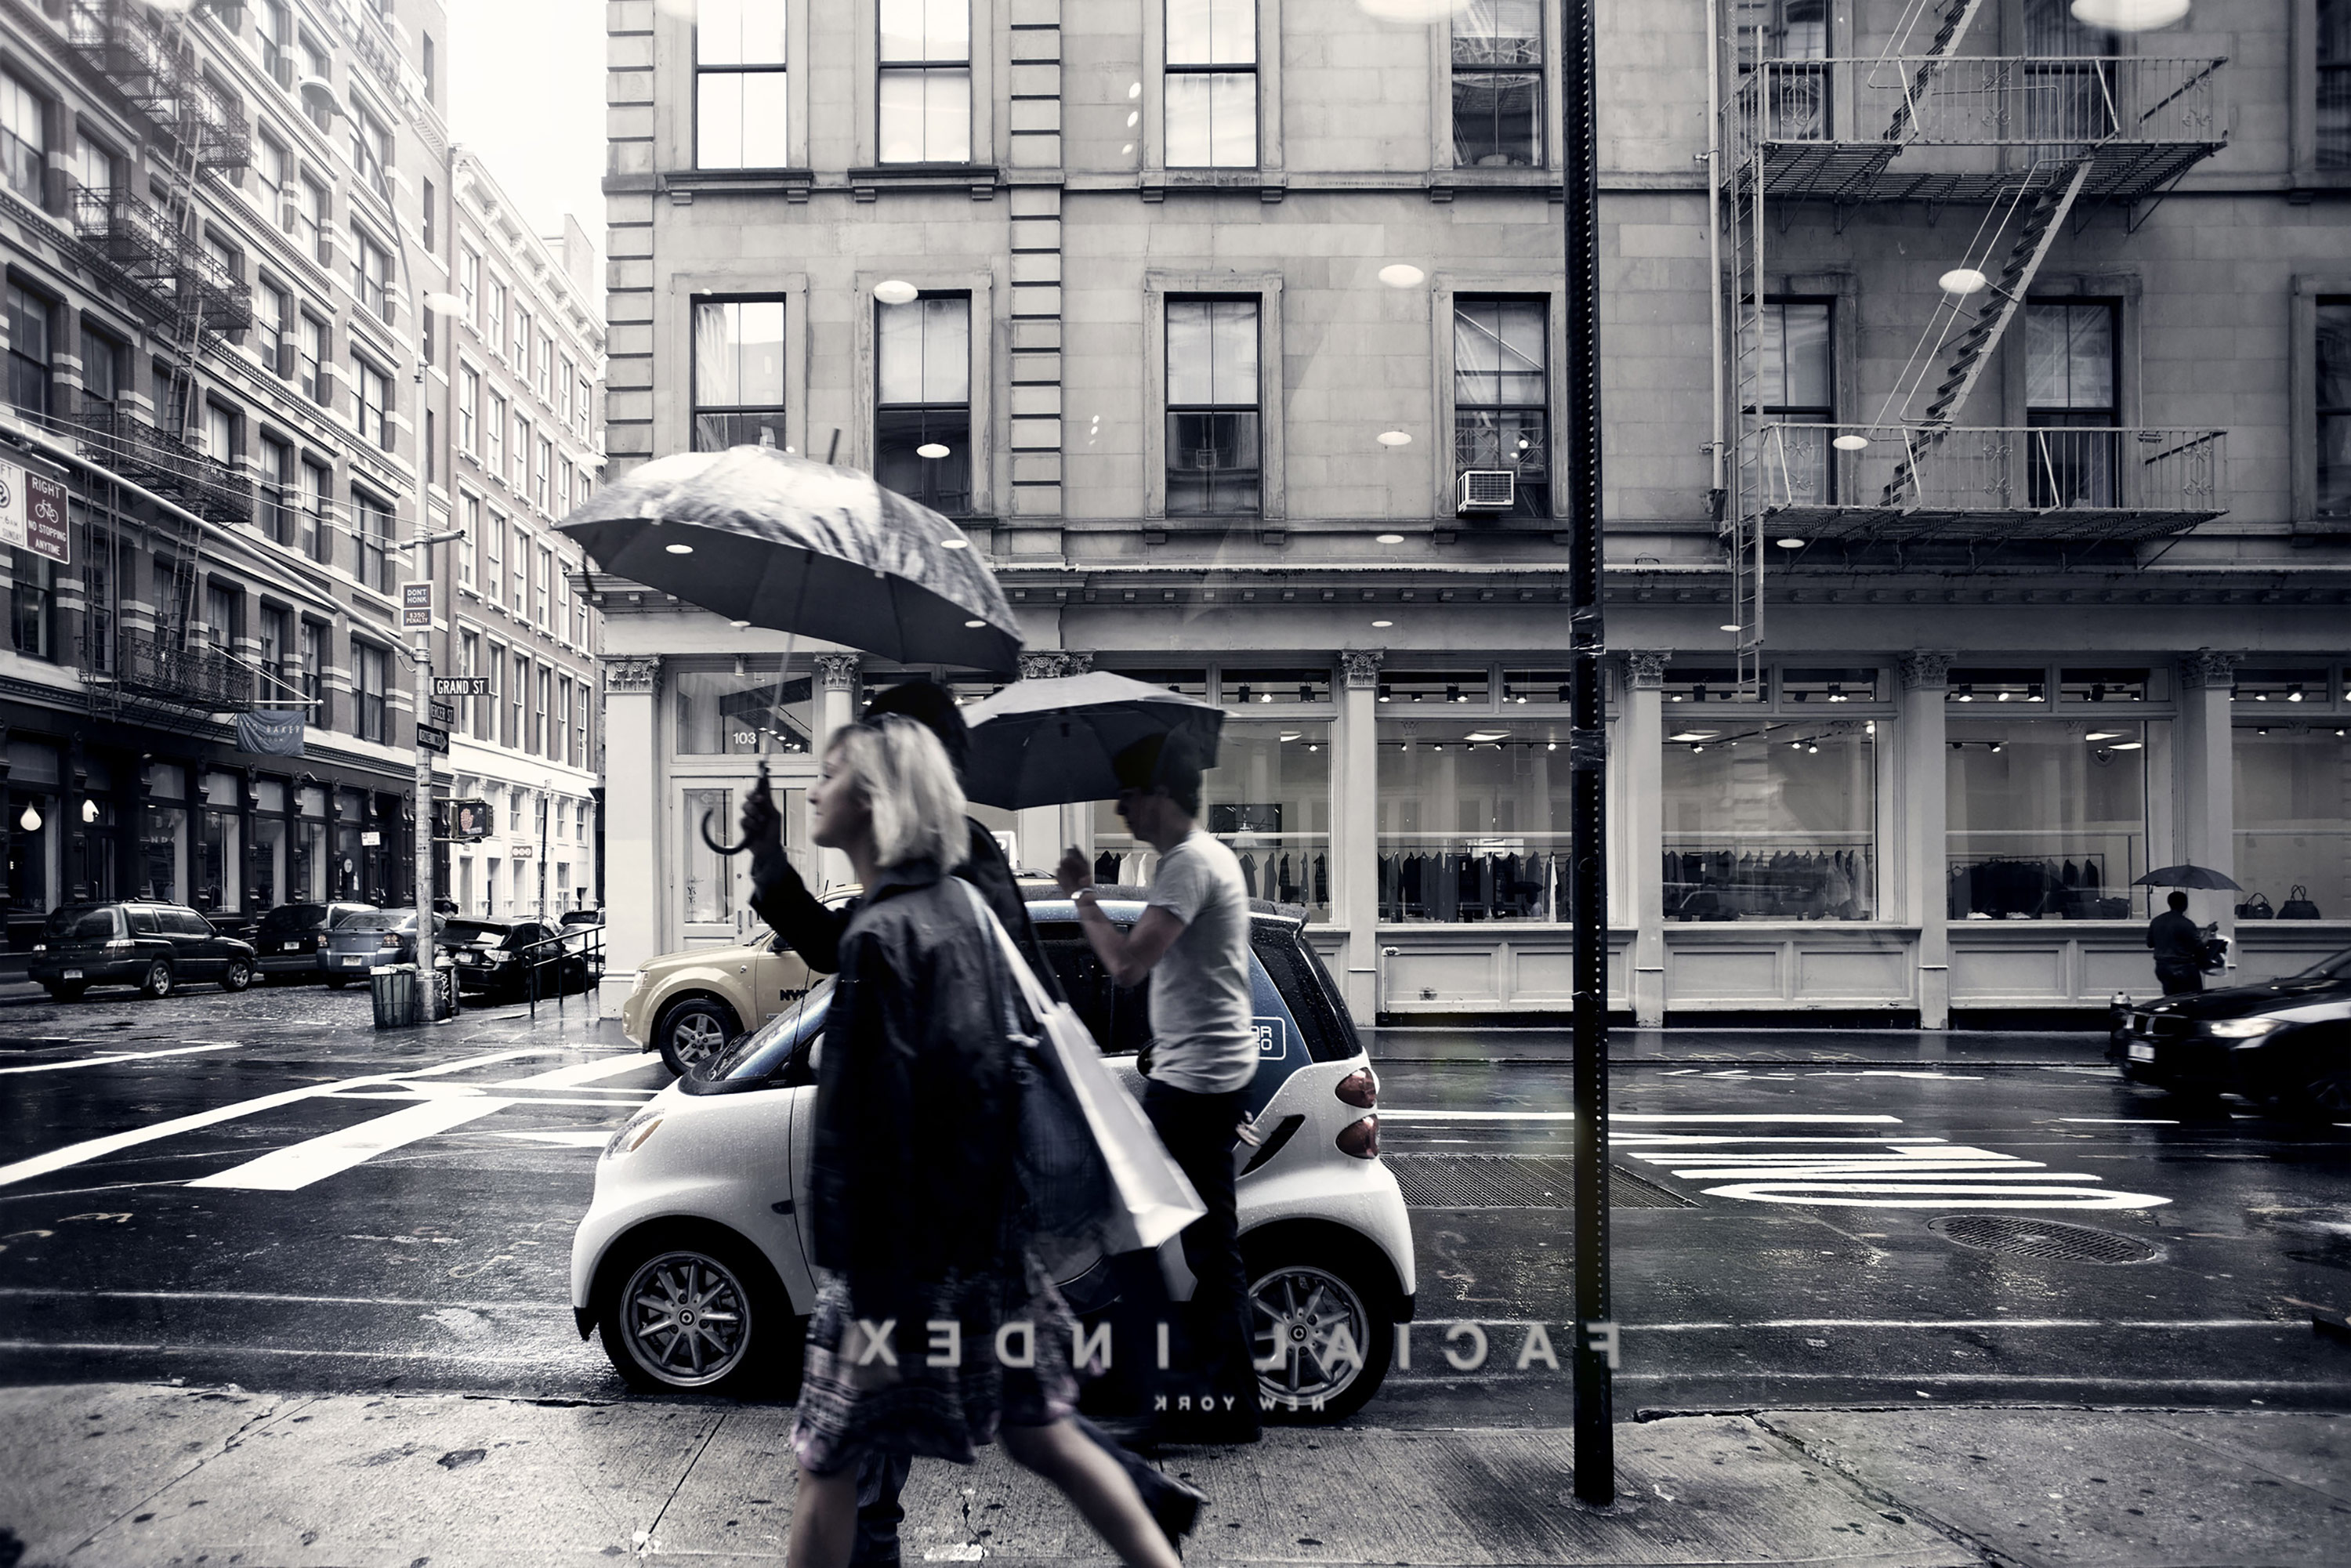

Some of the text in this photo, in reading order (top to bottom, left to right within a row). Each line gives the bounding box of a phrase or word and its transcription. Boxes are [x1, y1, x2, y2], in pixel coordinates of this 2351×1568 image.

[32, 476, 60, 498] RIGHT
[28, 520, 67, 542] NO STOPPING
[35, 538, 60, 556] ANYTIME
[437, 679, 484, 695] GRAND ST
[432, 704, 454, 722] ERCER ST
[266, 725, 301, 734] BAKER
[420, 730, 445, 746] ONE WAY
[733, 732, 757, 744] 103
[1249, 1025, 1272, 1038] AR
